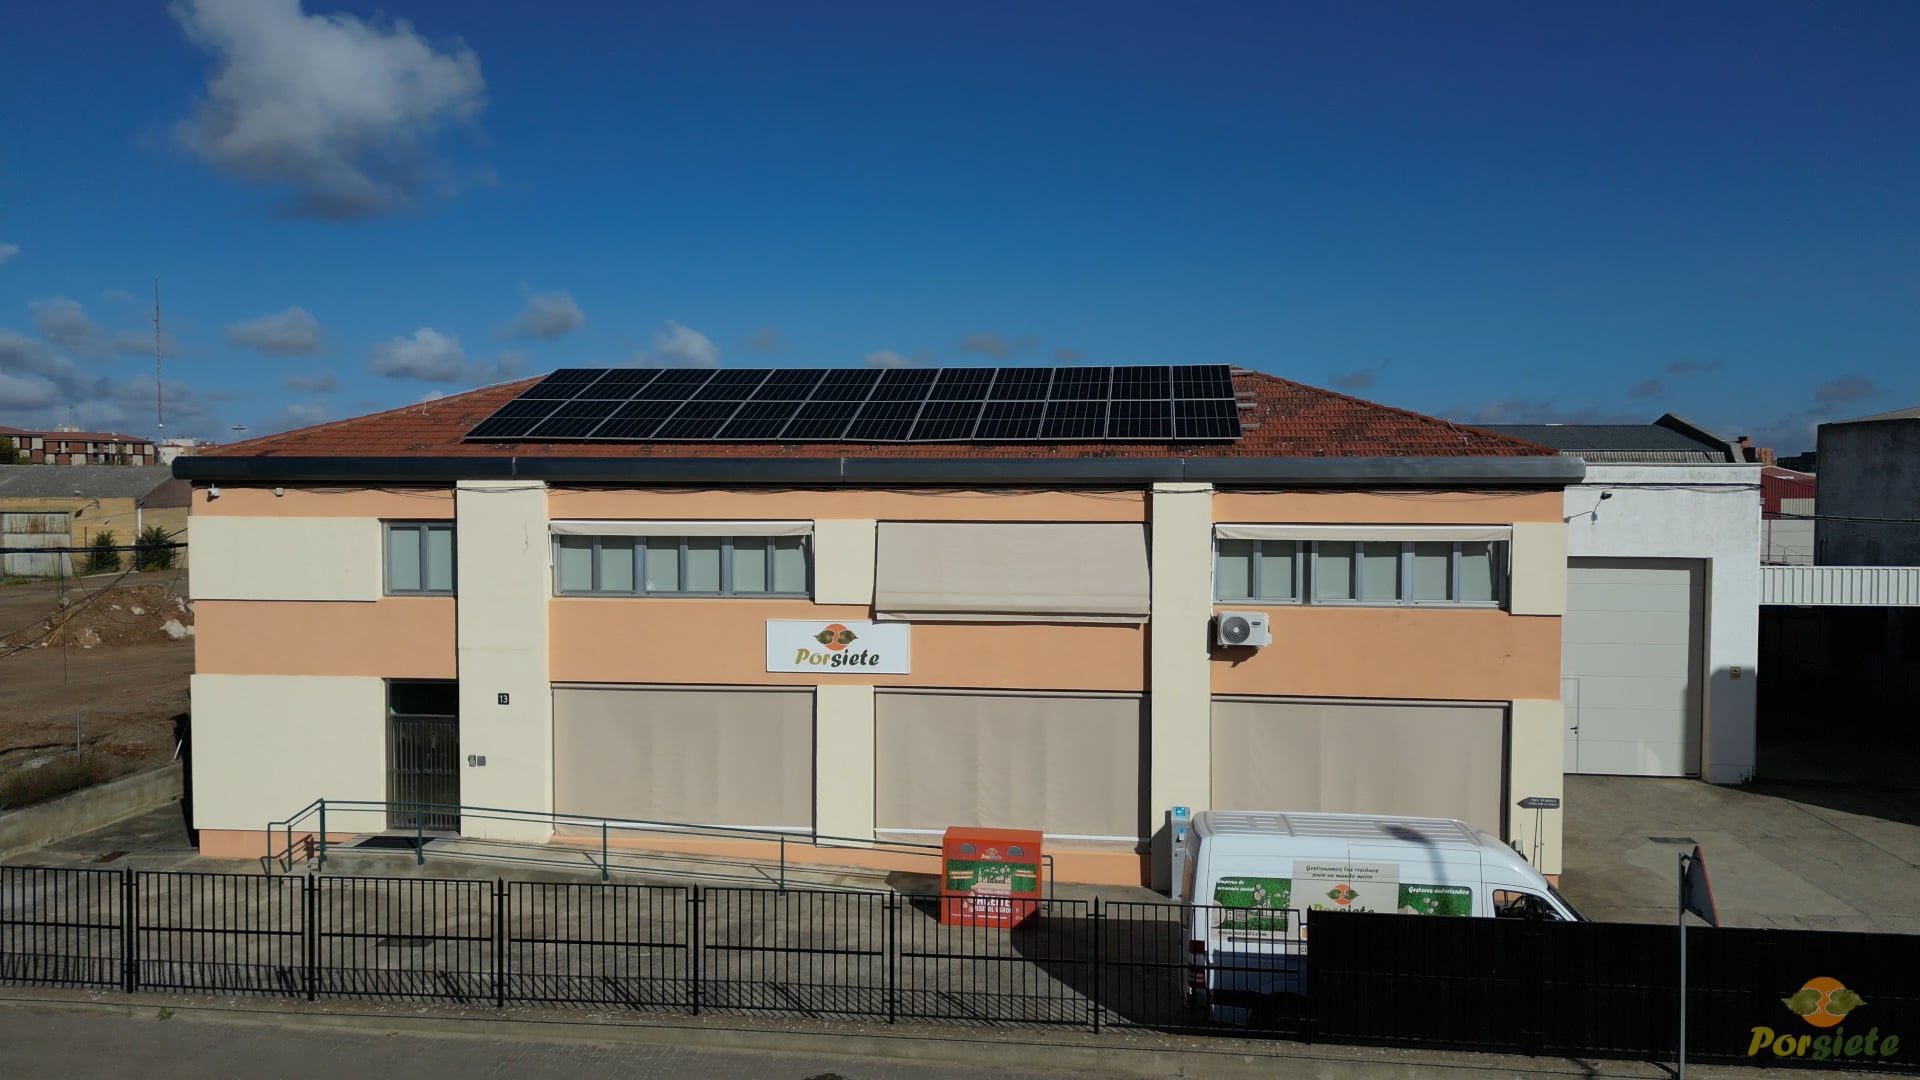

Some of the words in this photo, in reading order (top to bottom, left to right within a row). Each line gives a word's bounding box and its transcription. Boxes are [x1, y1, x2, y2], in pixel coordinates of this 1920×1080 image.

[795, 648, 879, 667] Porsiete
[499, 695, 508, 703] 13
[1408, 886, 1433, 894] Gestores
